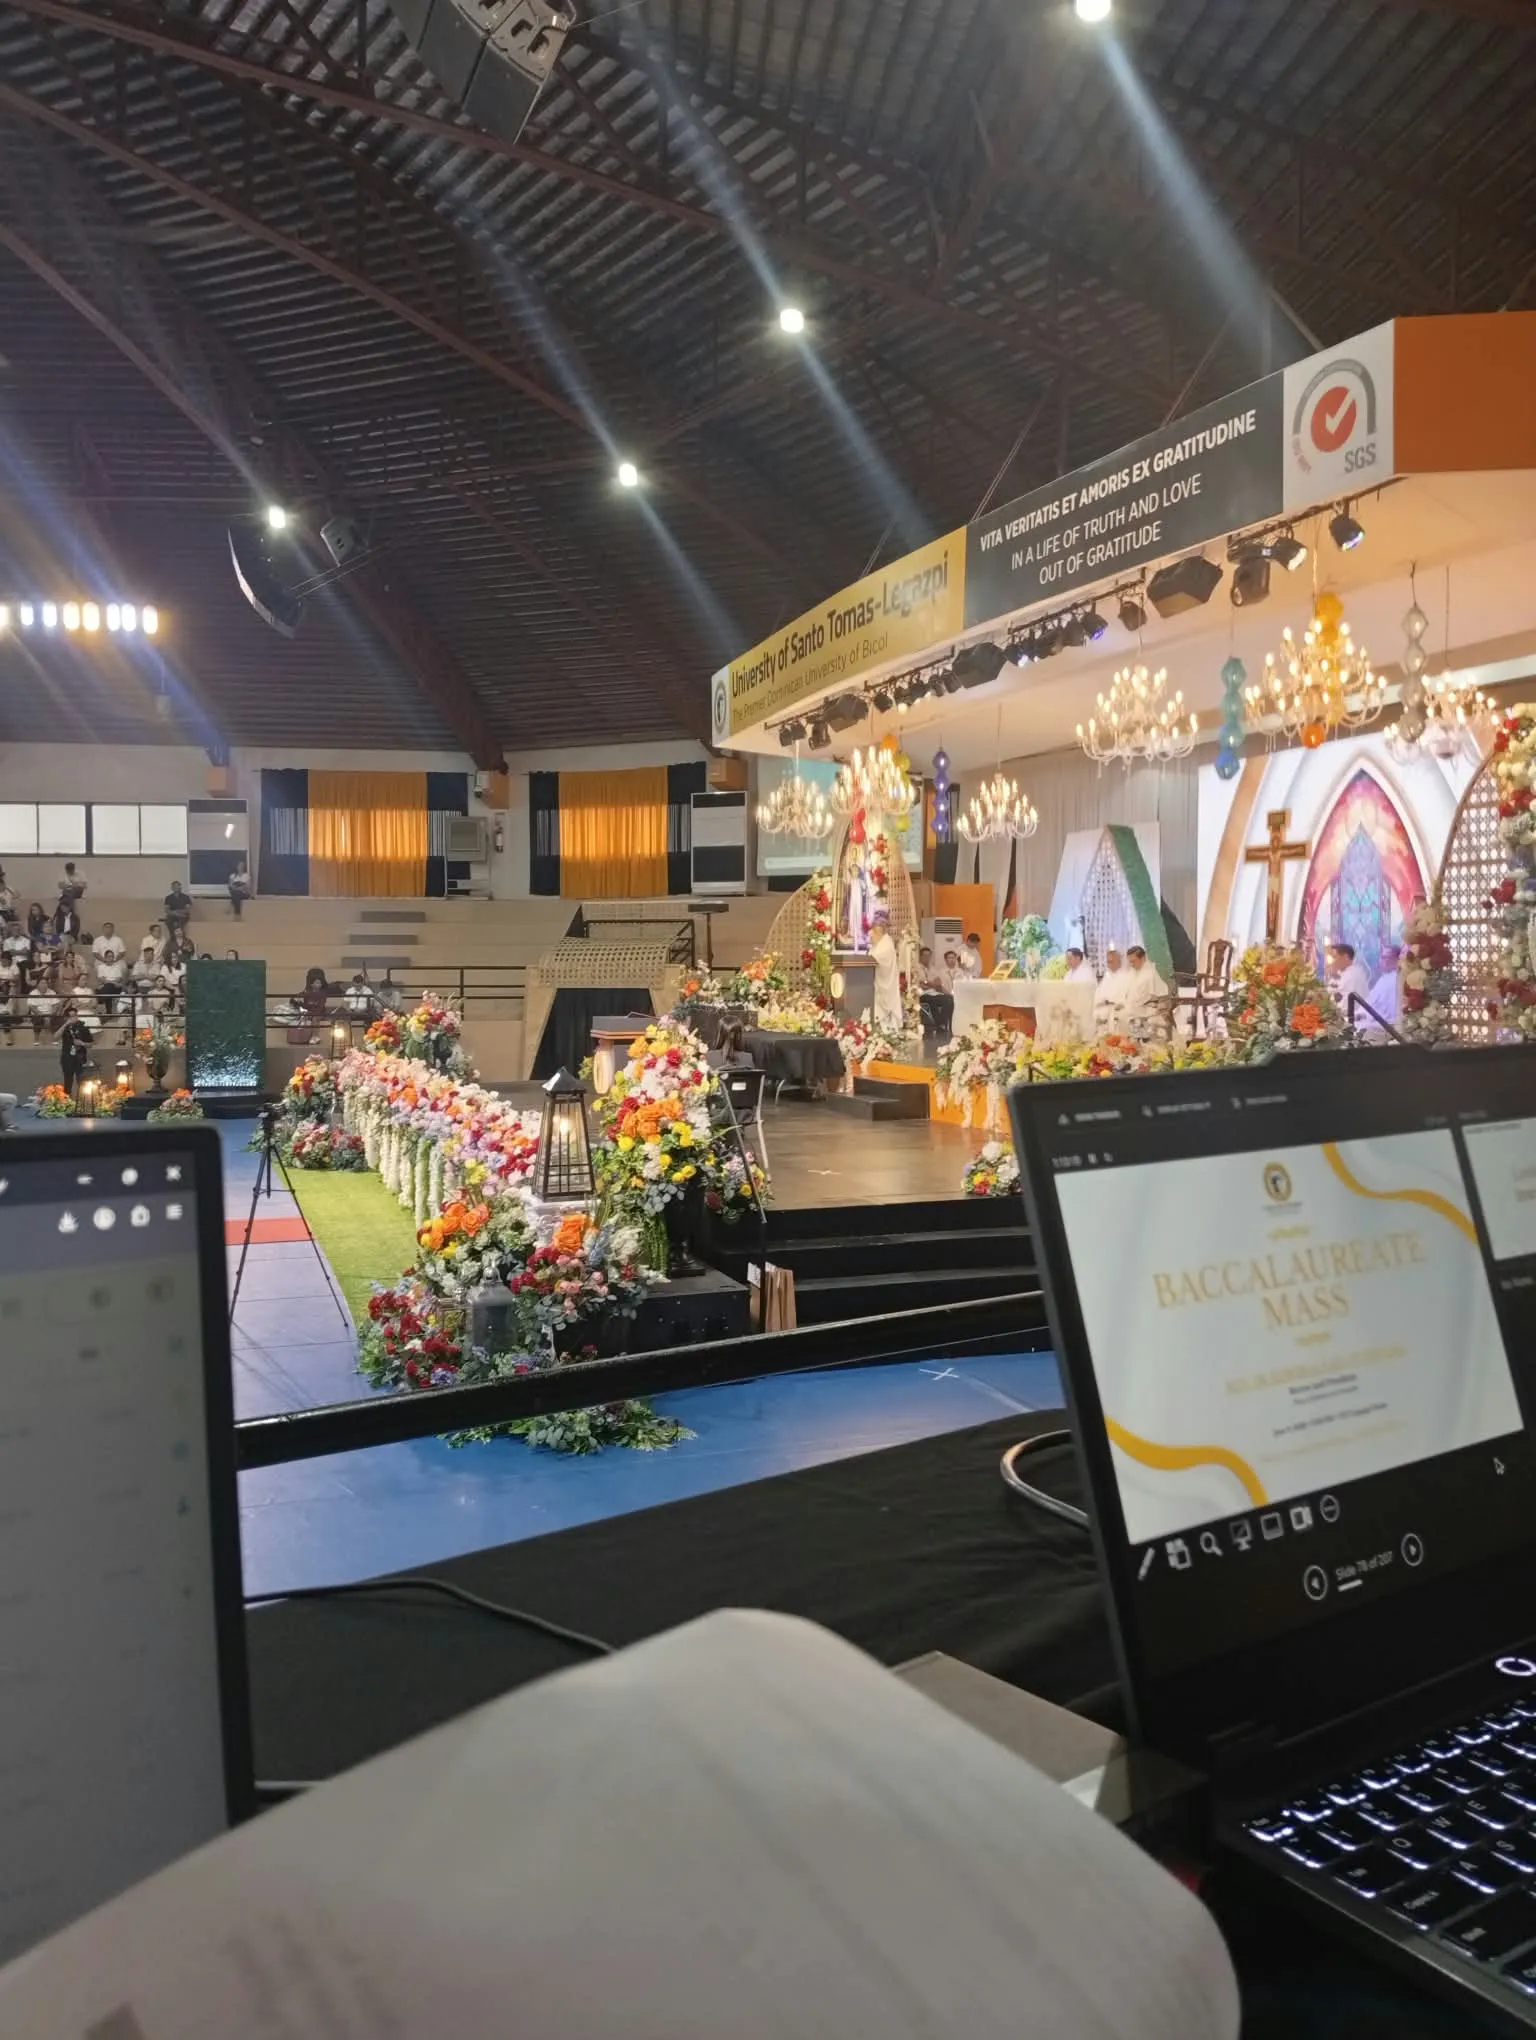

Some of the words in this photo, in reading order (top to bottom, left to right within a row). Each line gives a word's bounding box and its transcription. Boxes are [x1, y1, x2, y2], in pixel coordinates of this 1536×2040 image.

[980, 527, 1003, 552] VITA
[1004, 500, 1060, 540] VERITATIS
[1062, 492, 1077, 516] ET
[1079, 468, 1130, 508] AMORIS
[1132, 458, 1150, 483] EX
[1153, 409, 1257, 473] GRATITUDINE
[1343, 442, 1377, 474] SGS
[1011, 551, 1023, 571] IN
[1025, 547, 1034, 566] A
[1036, 535, 1061, 562] LIFE
[1063, 525, 1080, 548] OF
[1083, 506, 1125, 542] TRUTH
[1128, 492, 1160, 525] AND
[1163, 473, 1202, 508] LOVE
[1039, 562, 1063, 585] OUT
[1066, 551, 1084, 575] OF
[1087, 520, 1162, 567] GRATITUDE
[732, 651, 776, 698] University
[778, 636, 790, 673] of
[791, 623, 825, 664] Santo
[733, 706, 744, 722] The
[805, 653, 848, 687] University
[849, 641, 861, 663] of
[862, 631, 889, 661] Bicol
[1153, 1230, 1428, 1310] BACCALAUREATE
[1262, 1283, 1349, 1328] MASS
